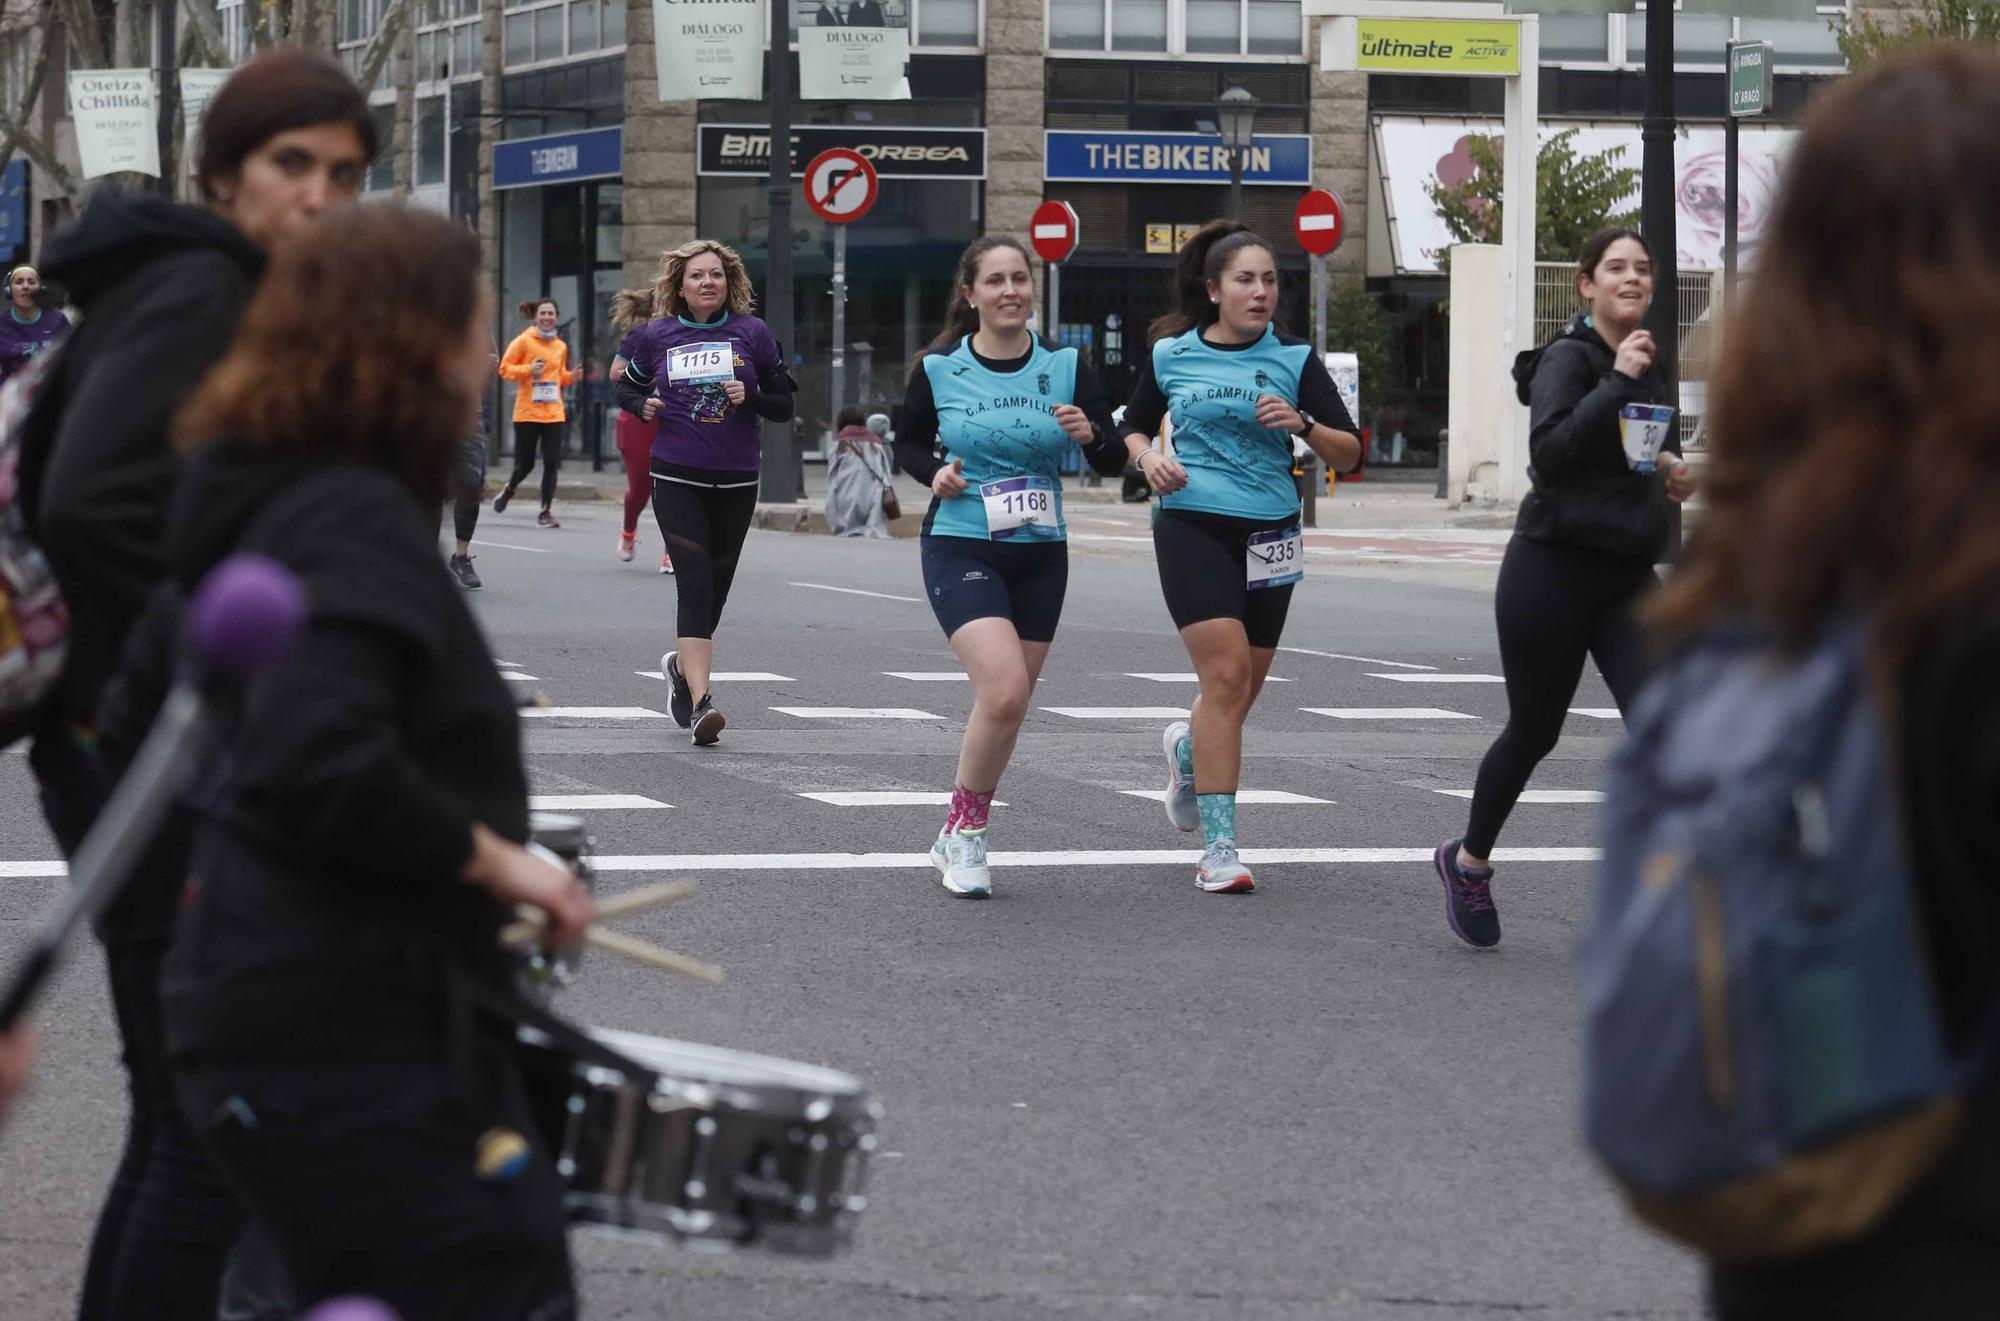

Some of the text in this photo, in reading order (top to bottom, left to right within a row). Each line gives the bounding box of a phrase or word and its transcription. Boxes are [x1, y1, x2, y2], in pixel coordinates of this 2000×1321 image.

[1362, 32, 1373, 41] bp
[1362, 38, 1453, 58] ultimate
[1465, 47, 1508, 56] ACTIVE
[78, 95, 150, 110] Chillida
[855, 145, 969, 160] ORBEA
[682, 351, 720, 368] 1115
[965, 402, 989, 417] C.A.
[1181, 393, 1202, 410] C.A.
[1003, 492, 1047, 515] 1168
[1265, 541, 1294, 564] 235
